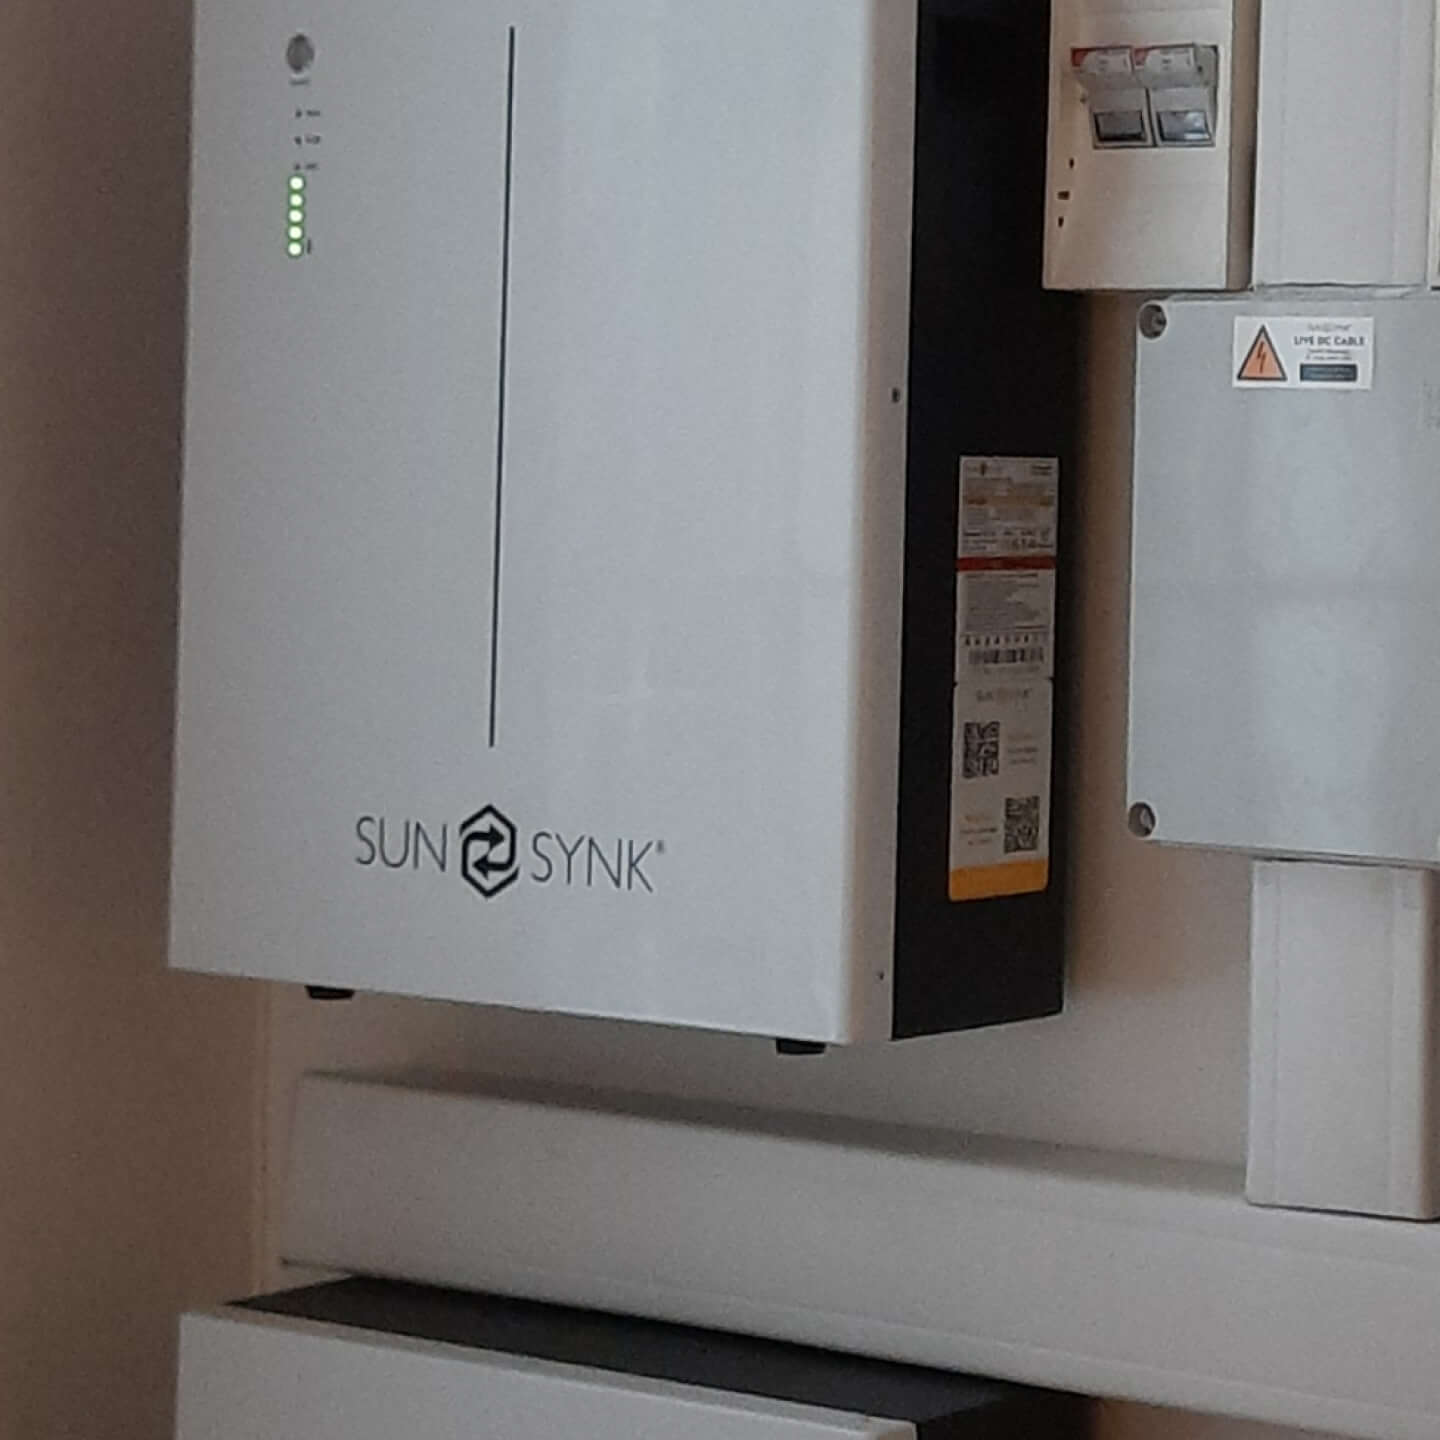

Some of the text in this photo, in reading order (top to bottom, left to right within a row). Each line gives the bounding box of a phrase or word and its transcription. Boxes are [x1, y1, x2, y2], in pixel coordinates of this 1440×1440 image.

[1294, 335, 1365, 345] LIVE DC CABLE
[355, 816, 448, 872] SUN
